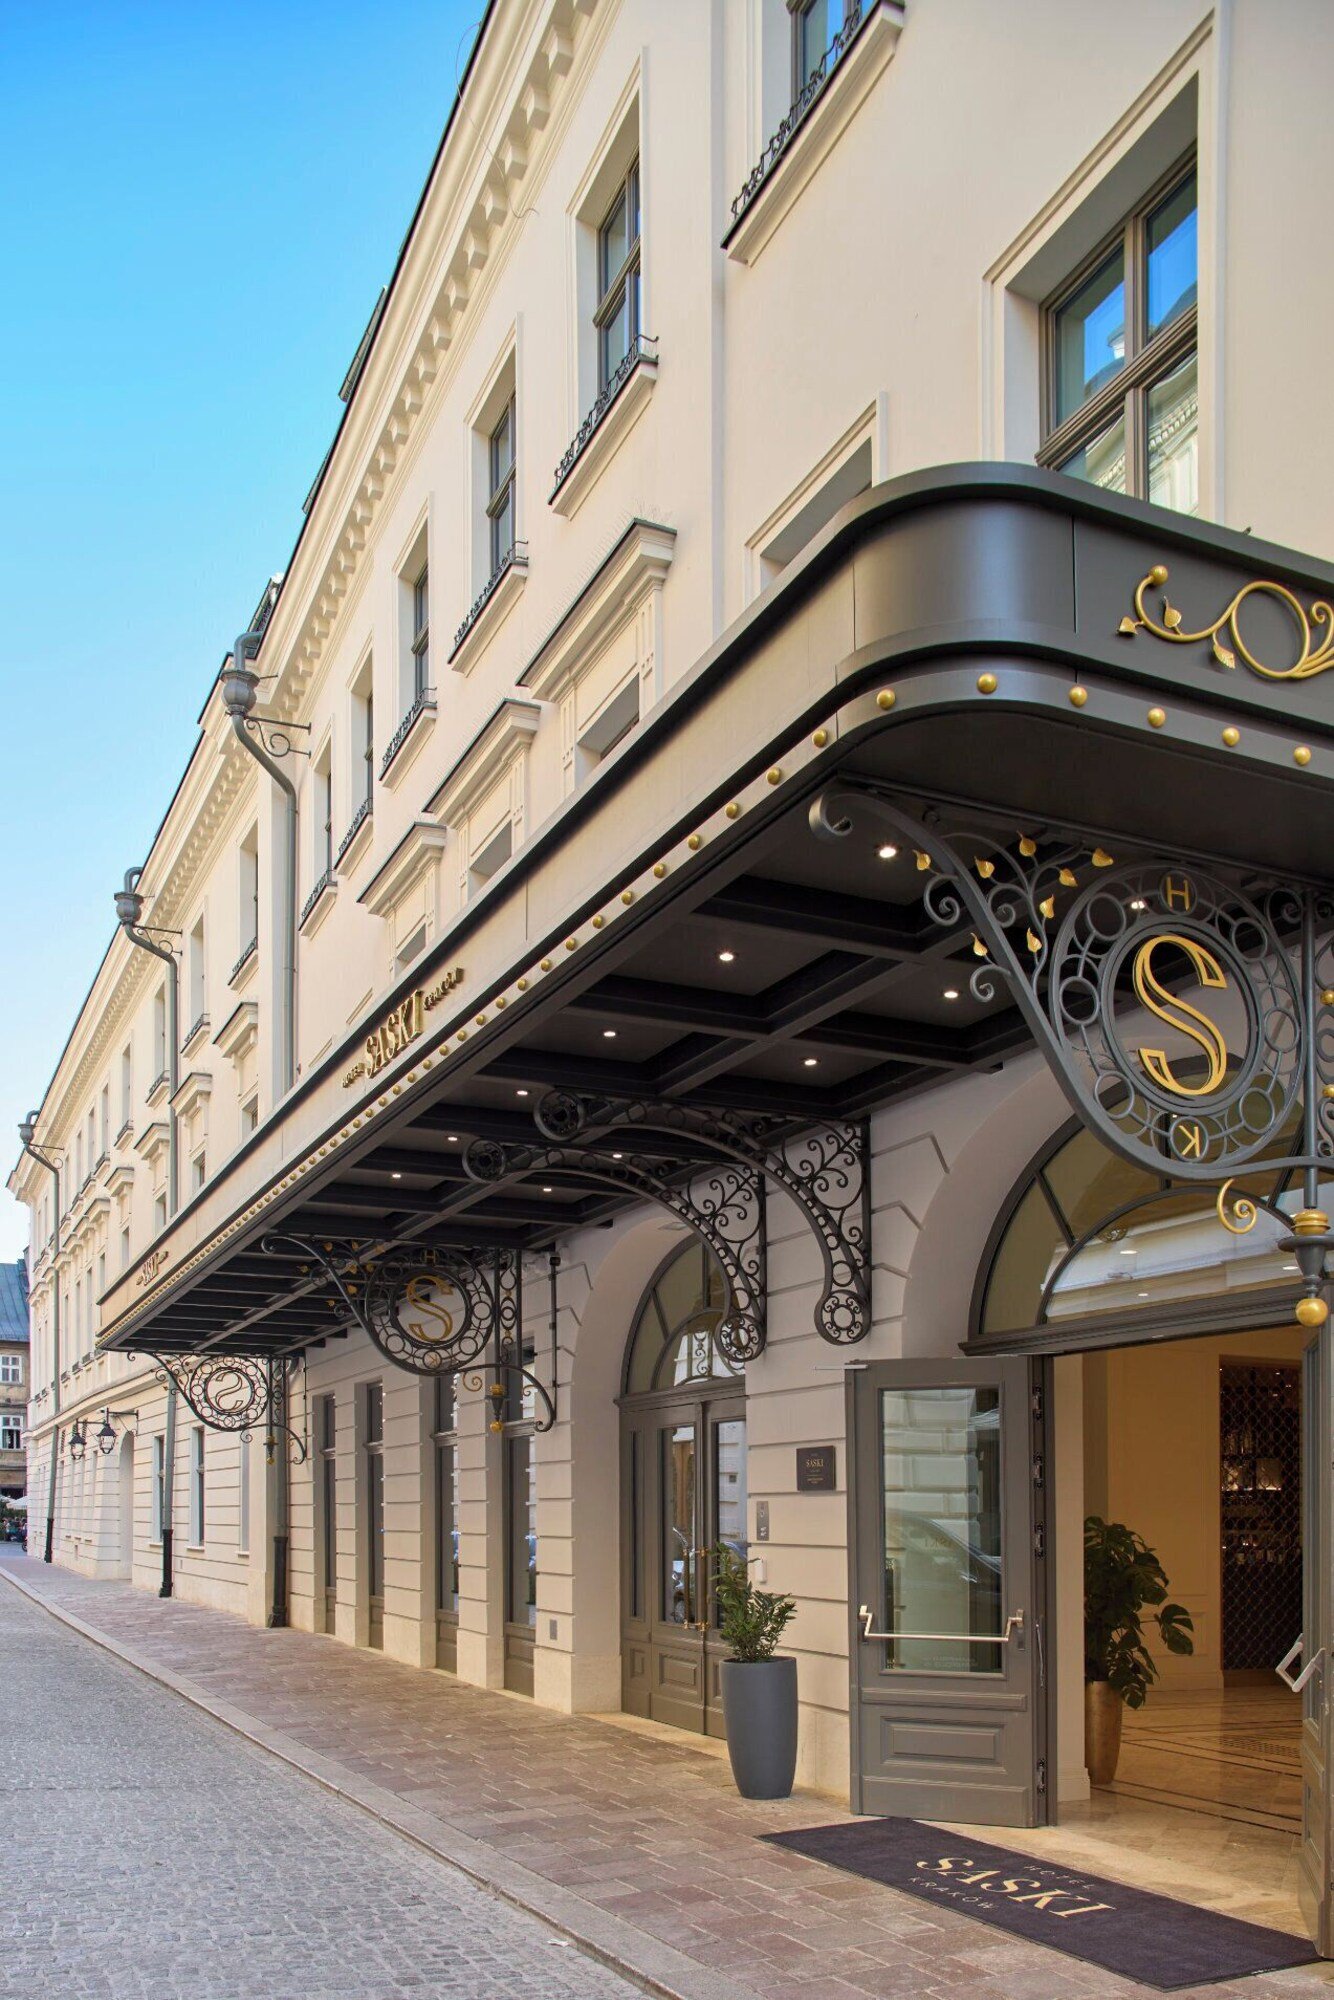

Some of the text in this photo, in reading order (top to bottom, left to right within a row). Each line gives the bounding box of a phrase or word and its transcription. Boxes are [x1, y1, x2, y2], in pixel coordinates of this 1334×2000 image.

[365, 989, 424, 1079] SASKI
[1132, 935, 1228, 1096] S
[406, 1275, 454, 1342] S
[915, 1857, 1118, 1918] SASKI
